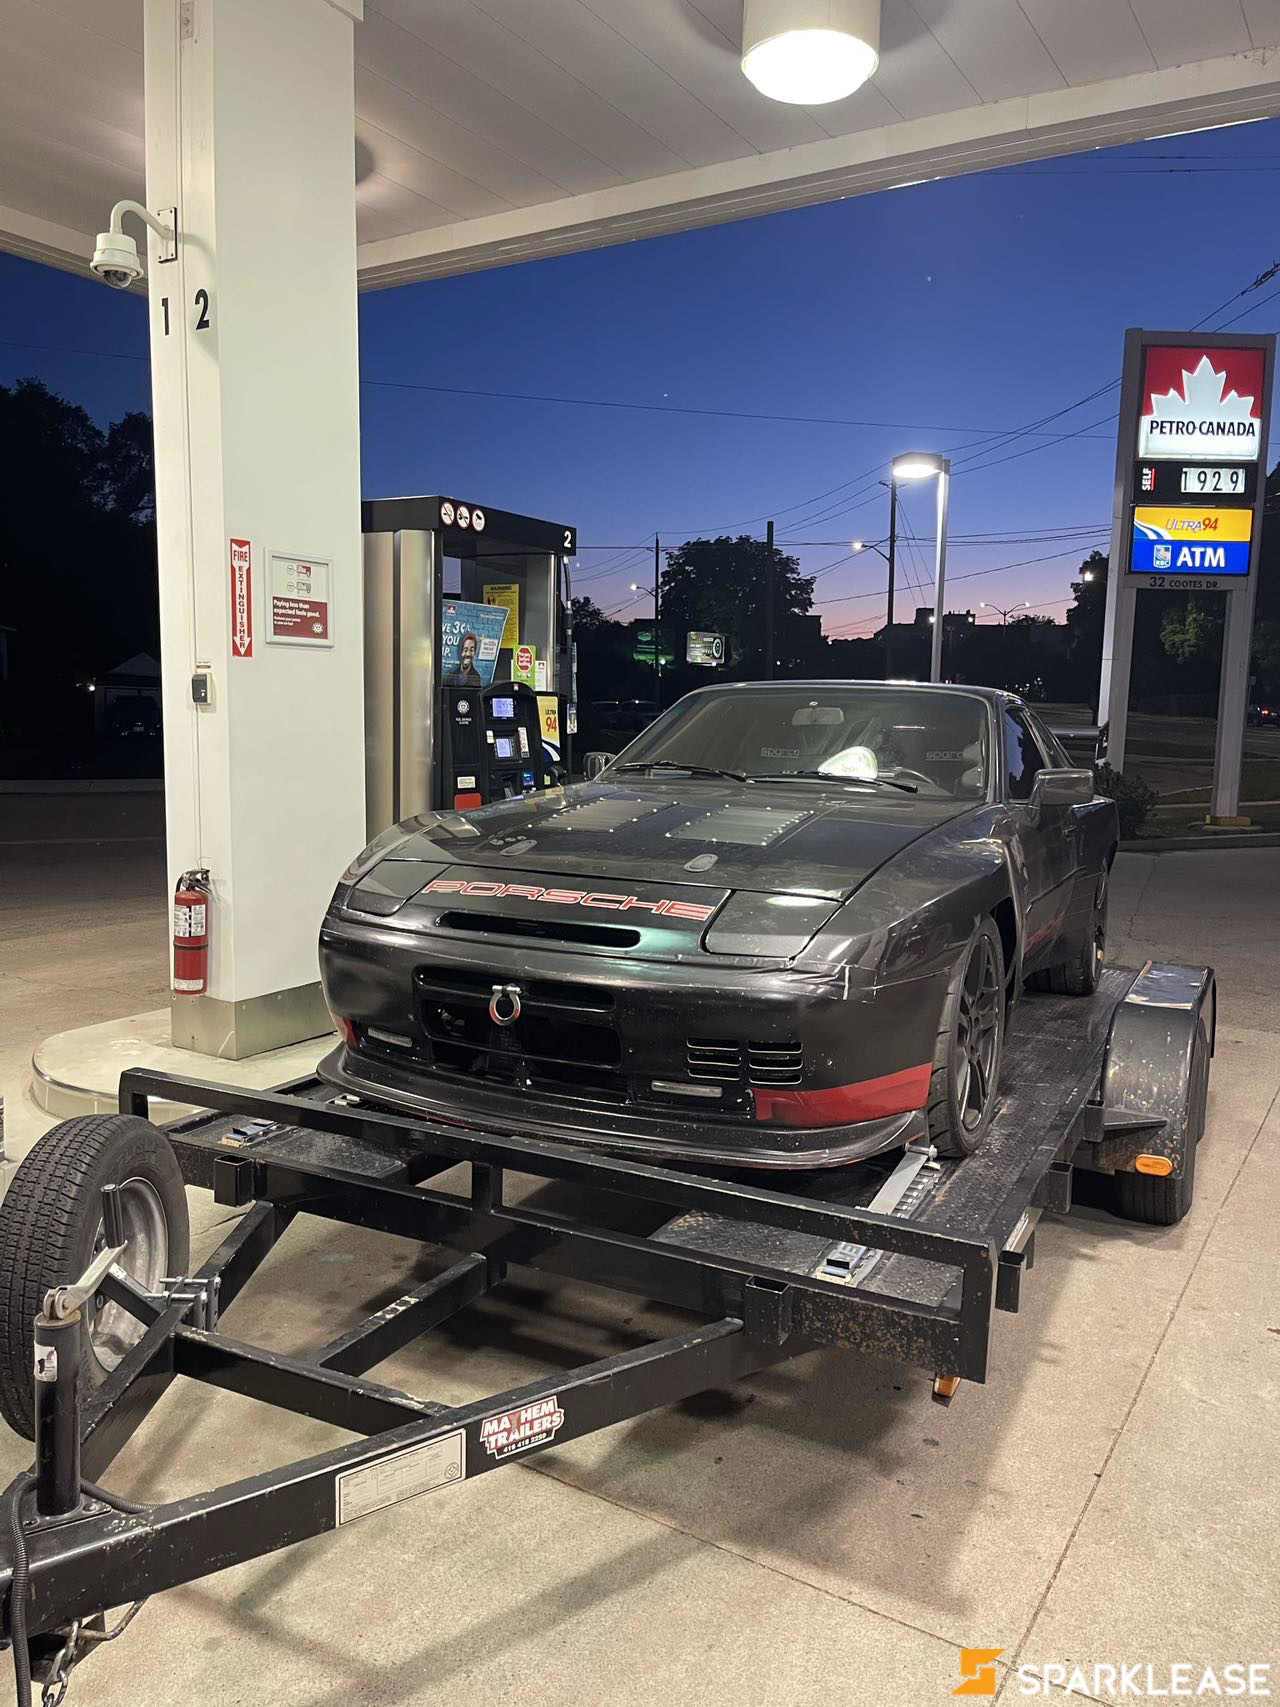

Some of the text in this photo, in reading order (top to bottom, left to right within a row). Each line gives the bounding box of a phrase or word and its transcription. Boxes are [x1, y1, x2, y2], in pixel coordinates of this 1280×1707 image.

[161, 297, 170, 337] 1
[194, 288, 210, 330] 2
[1150, 420, 1256, 437] PETRO-CANADA
[1141, 467, 1152, 491] SELF
[563, 530, 572, 548] 2
[233, 550, 248, 563] FIRE
[1176, 546, 1225, 568] ATM
[1149, 576, 1166, 588] 32
[1168, 580, 1203, 589] COOTES
[237, 565, 246, 649] EXTINGUISHER
[443, 634, 460, 646] YOU
[546, 715, 558, 733] 94
[421, 879, 716, 922] PORSCHE
[488, 1412, 561, 1449] TRAILERS
